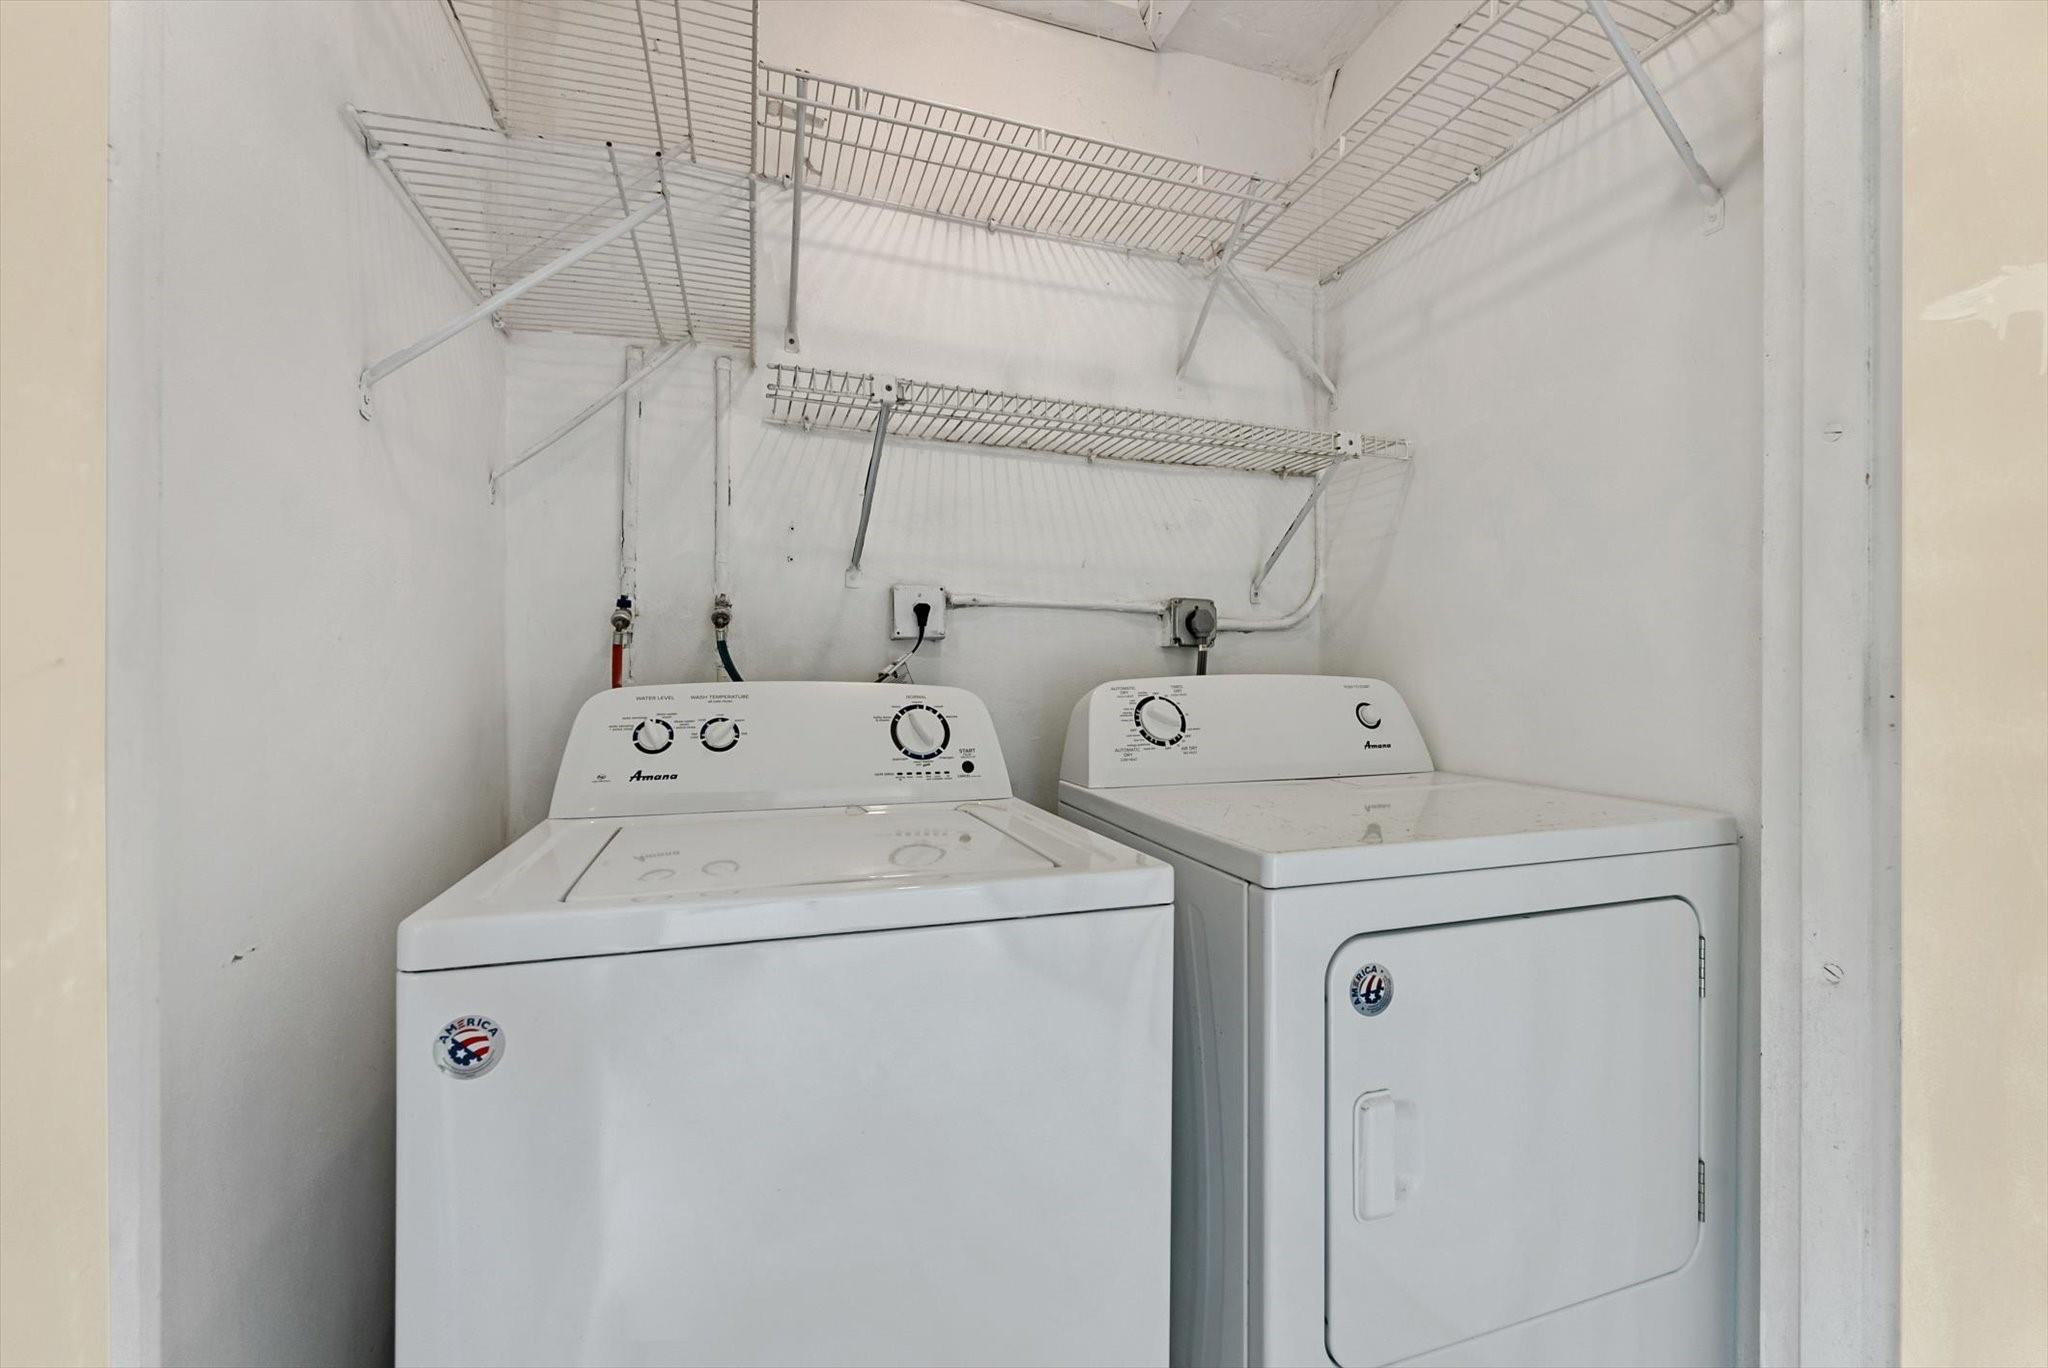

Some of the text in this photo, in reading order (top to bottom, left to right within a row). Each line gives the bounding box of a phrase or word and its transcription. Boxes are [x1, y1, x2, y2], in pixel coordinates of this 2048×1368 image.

[1364, 740, 1391, 750] Amana
[629, 769, 678, 782] Amana
[1351, 965, 1377, 1005] AMERICA
[439, 1018, 498, 1044] AMERICA
